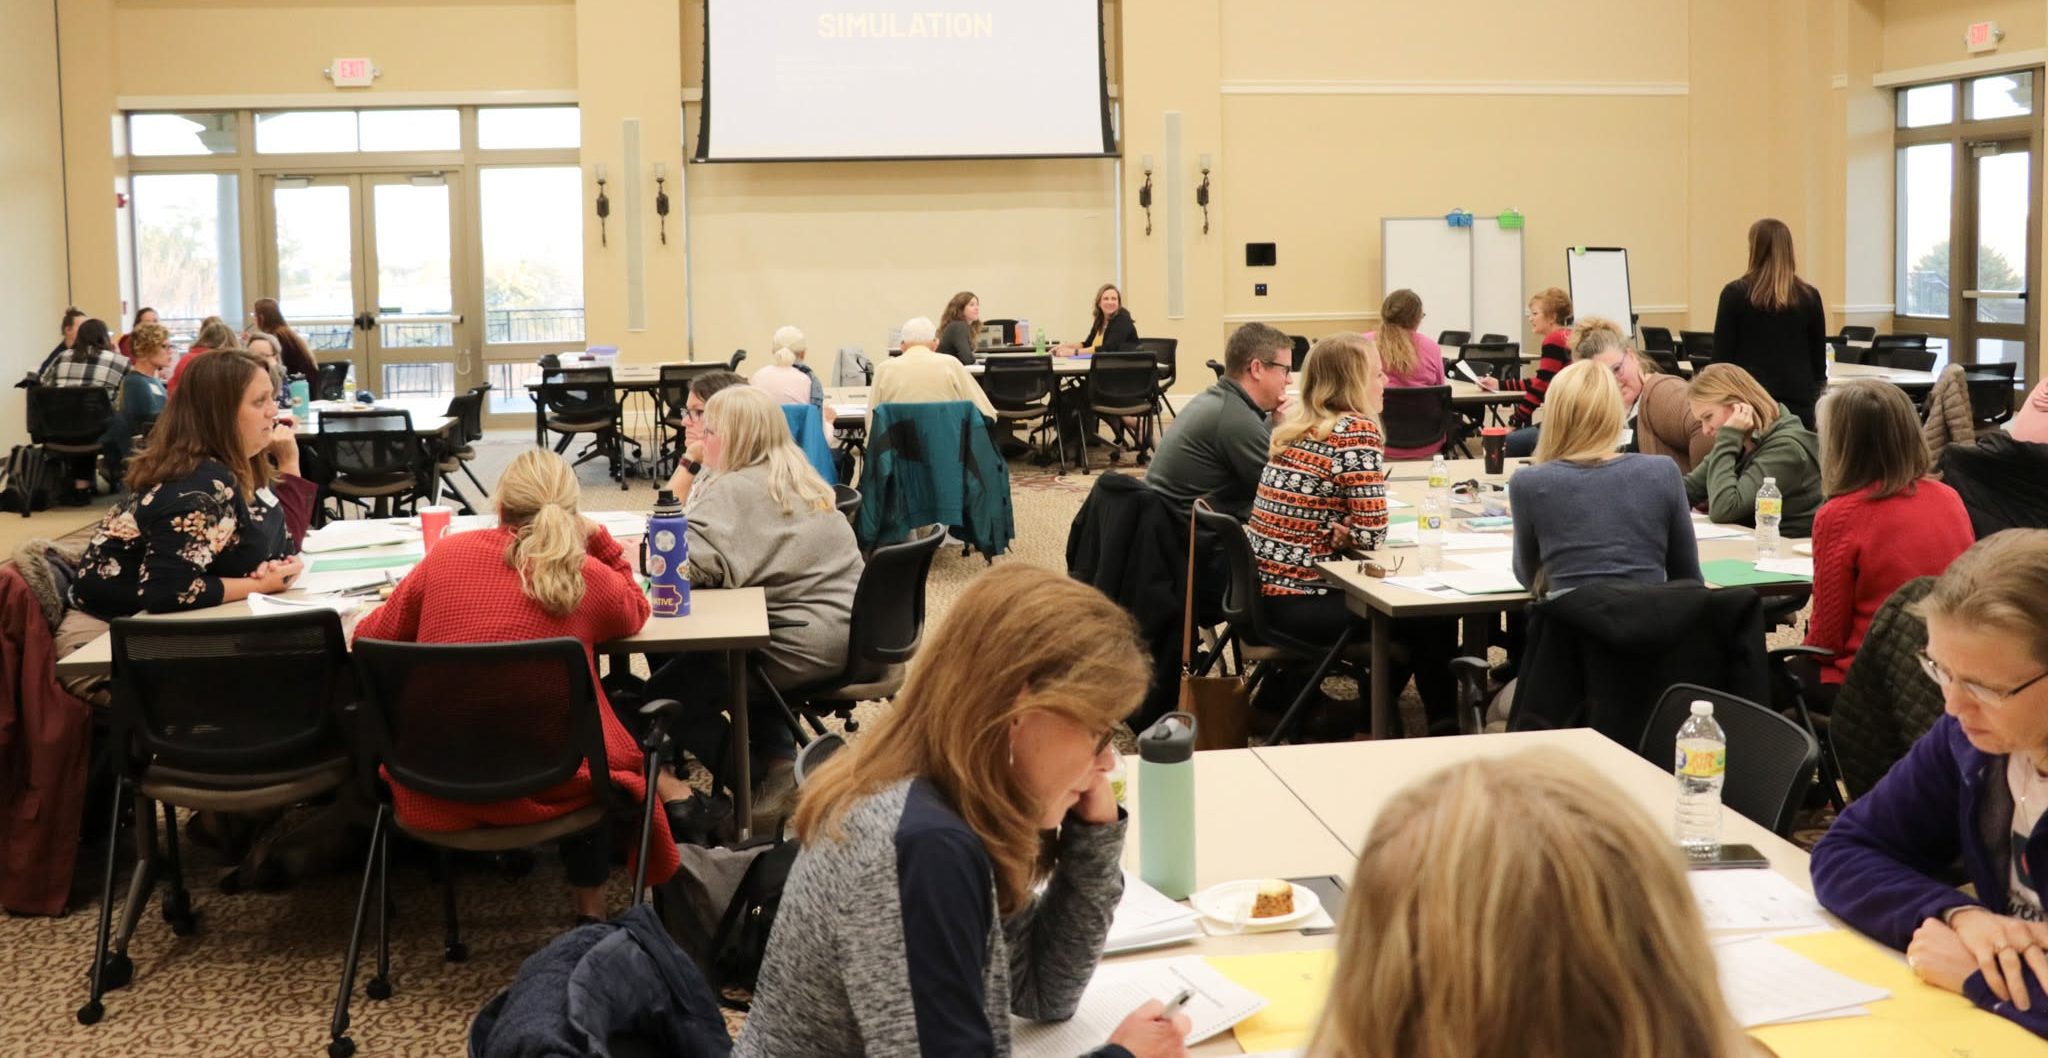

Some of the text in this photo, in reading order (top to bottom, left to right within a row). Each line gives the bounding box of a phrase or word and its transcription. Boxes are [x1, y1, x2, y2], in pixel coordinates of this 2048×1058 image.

[817, 12, 993, 38] SIMULATION
[1970, 22, 1990, 45] EXIT
[339, 60, 367, 79] EXIT
[652, 597, 674, 606] ATIVE
